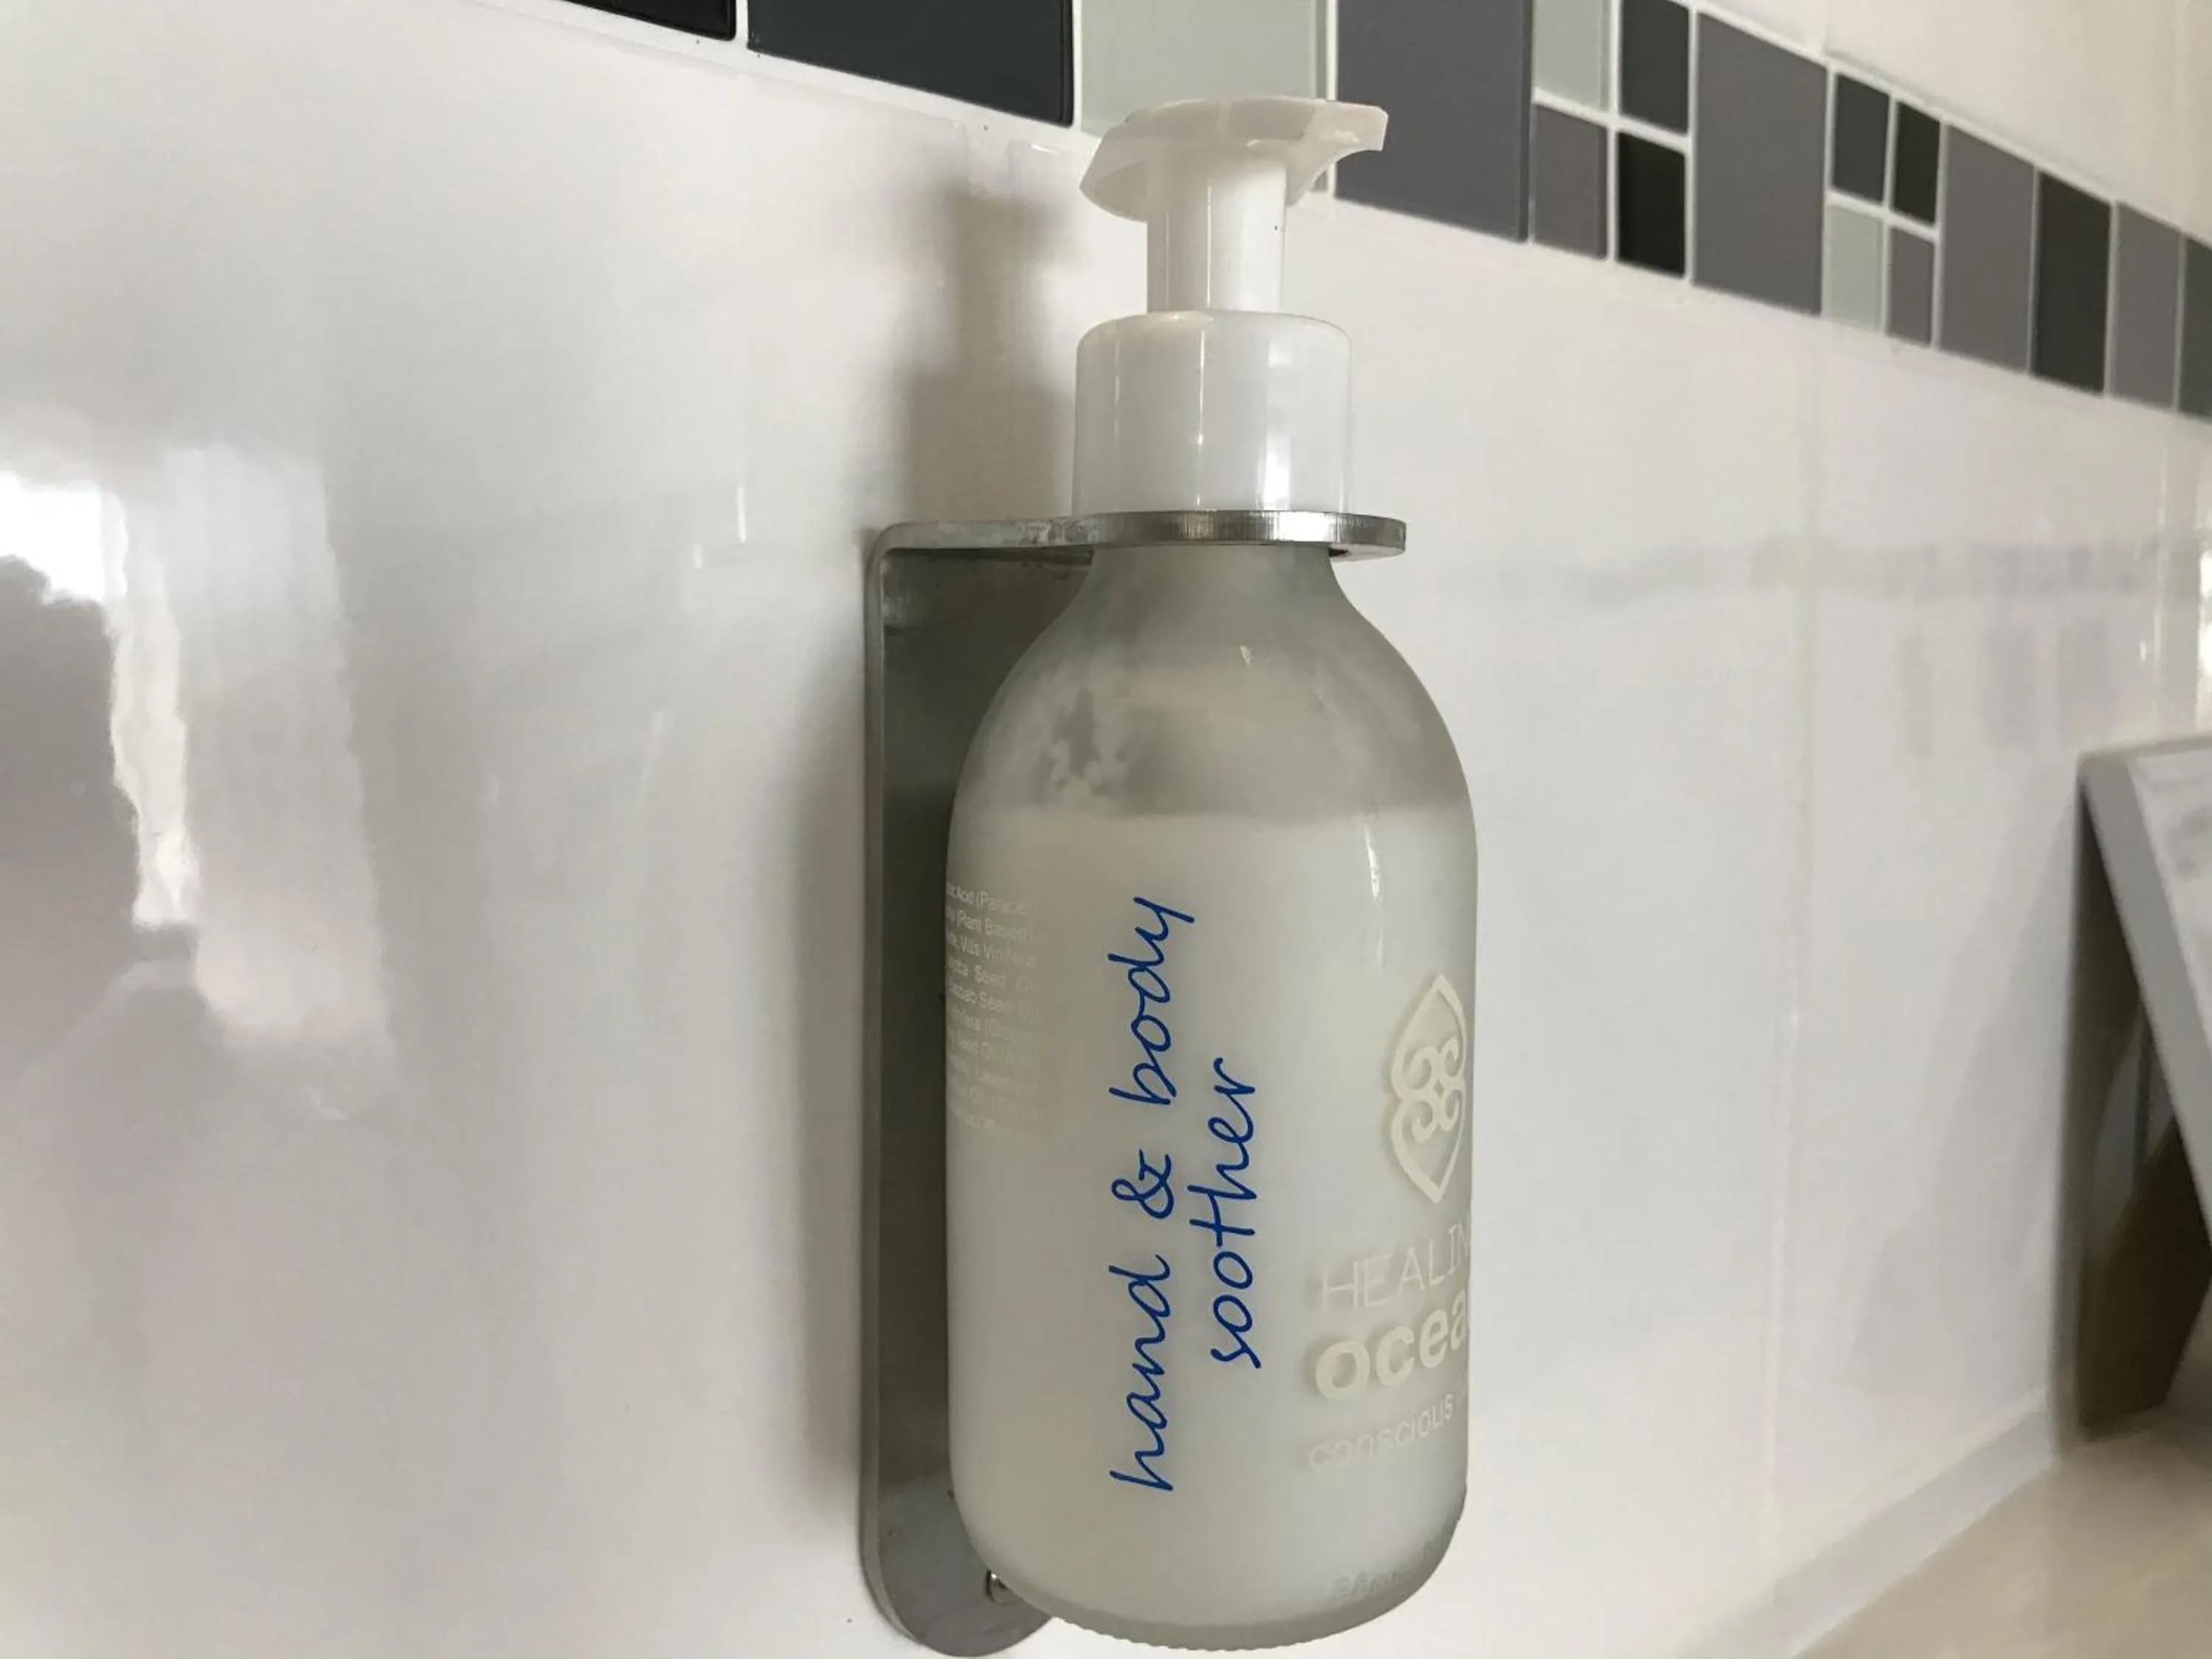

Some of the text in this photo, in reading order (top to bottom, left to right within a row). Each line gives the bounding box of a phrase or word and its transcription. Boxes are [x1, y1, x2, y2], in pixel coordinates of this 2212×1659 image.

[1107, 896, 1195, 1491] hand & body
[1186, 1057, 1262, 1368] soother
[1310, 1394, 1454, 1470] conscious
